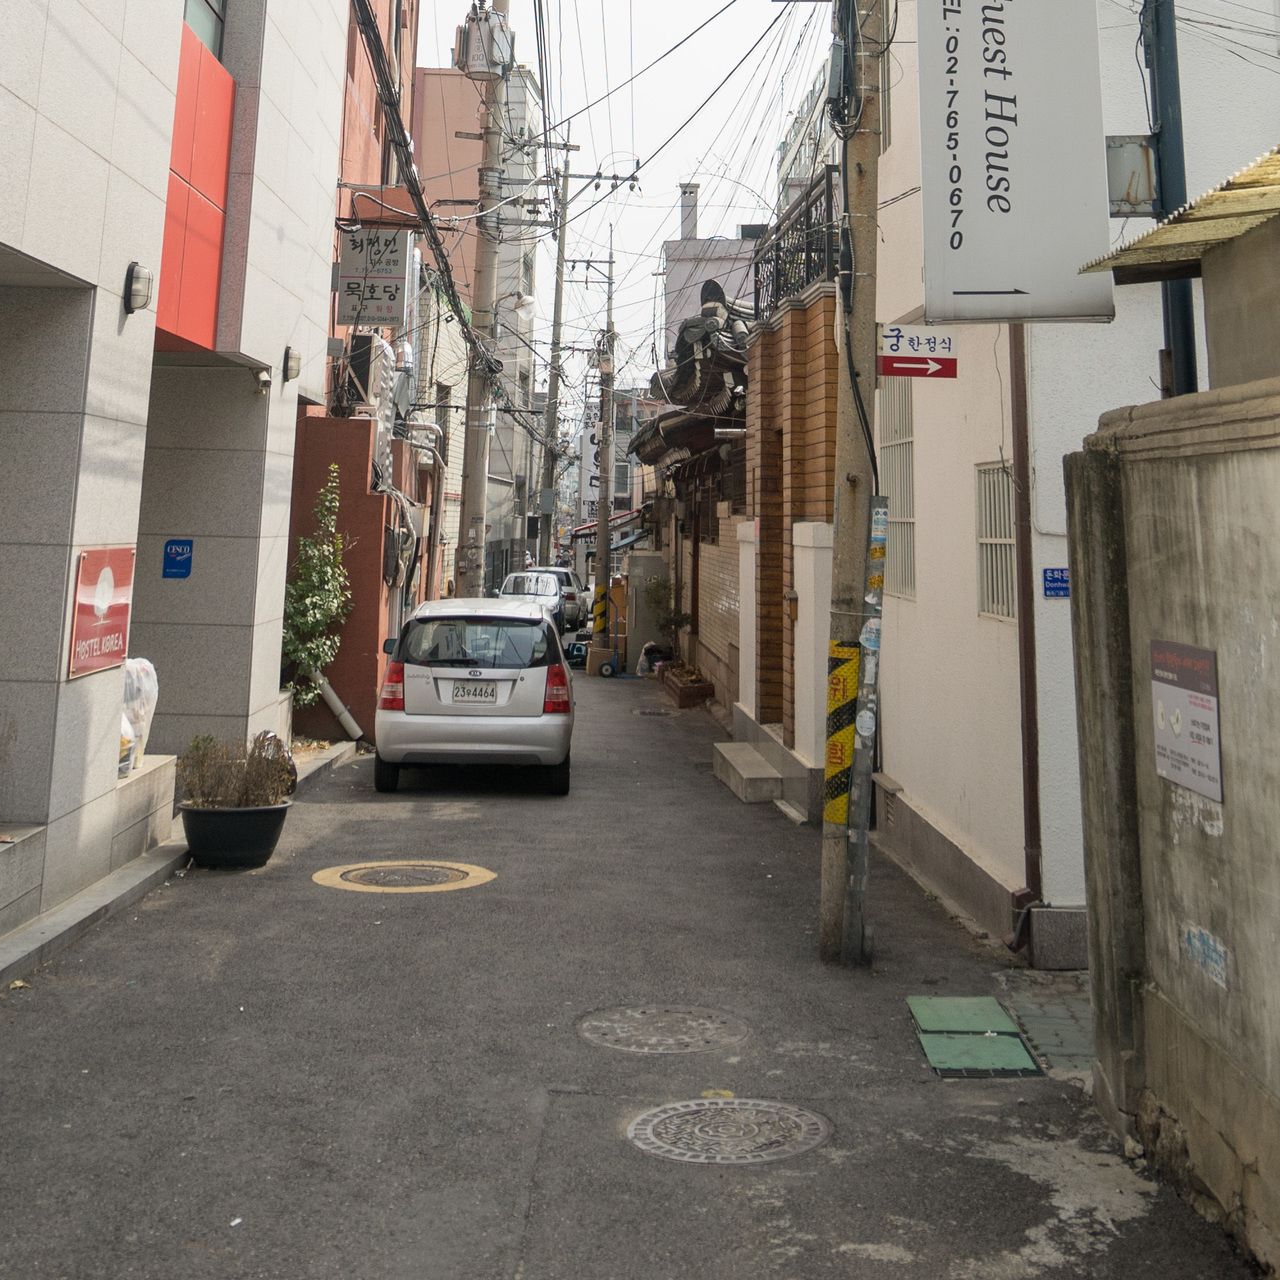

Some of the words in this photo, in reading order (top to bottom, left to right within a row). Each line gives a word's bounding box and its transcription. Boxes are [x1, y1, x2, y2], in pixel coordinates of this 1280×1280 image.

[983, 91, 1019, 214] House
[344, 282, 400, 301] 묵호당
[882, 327, 904, 352] 궁
[907, 336, 951, 352] 한정식
